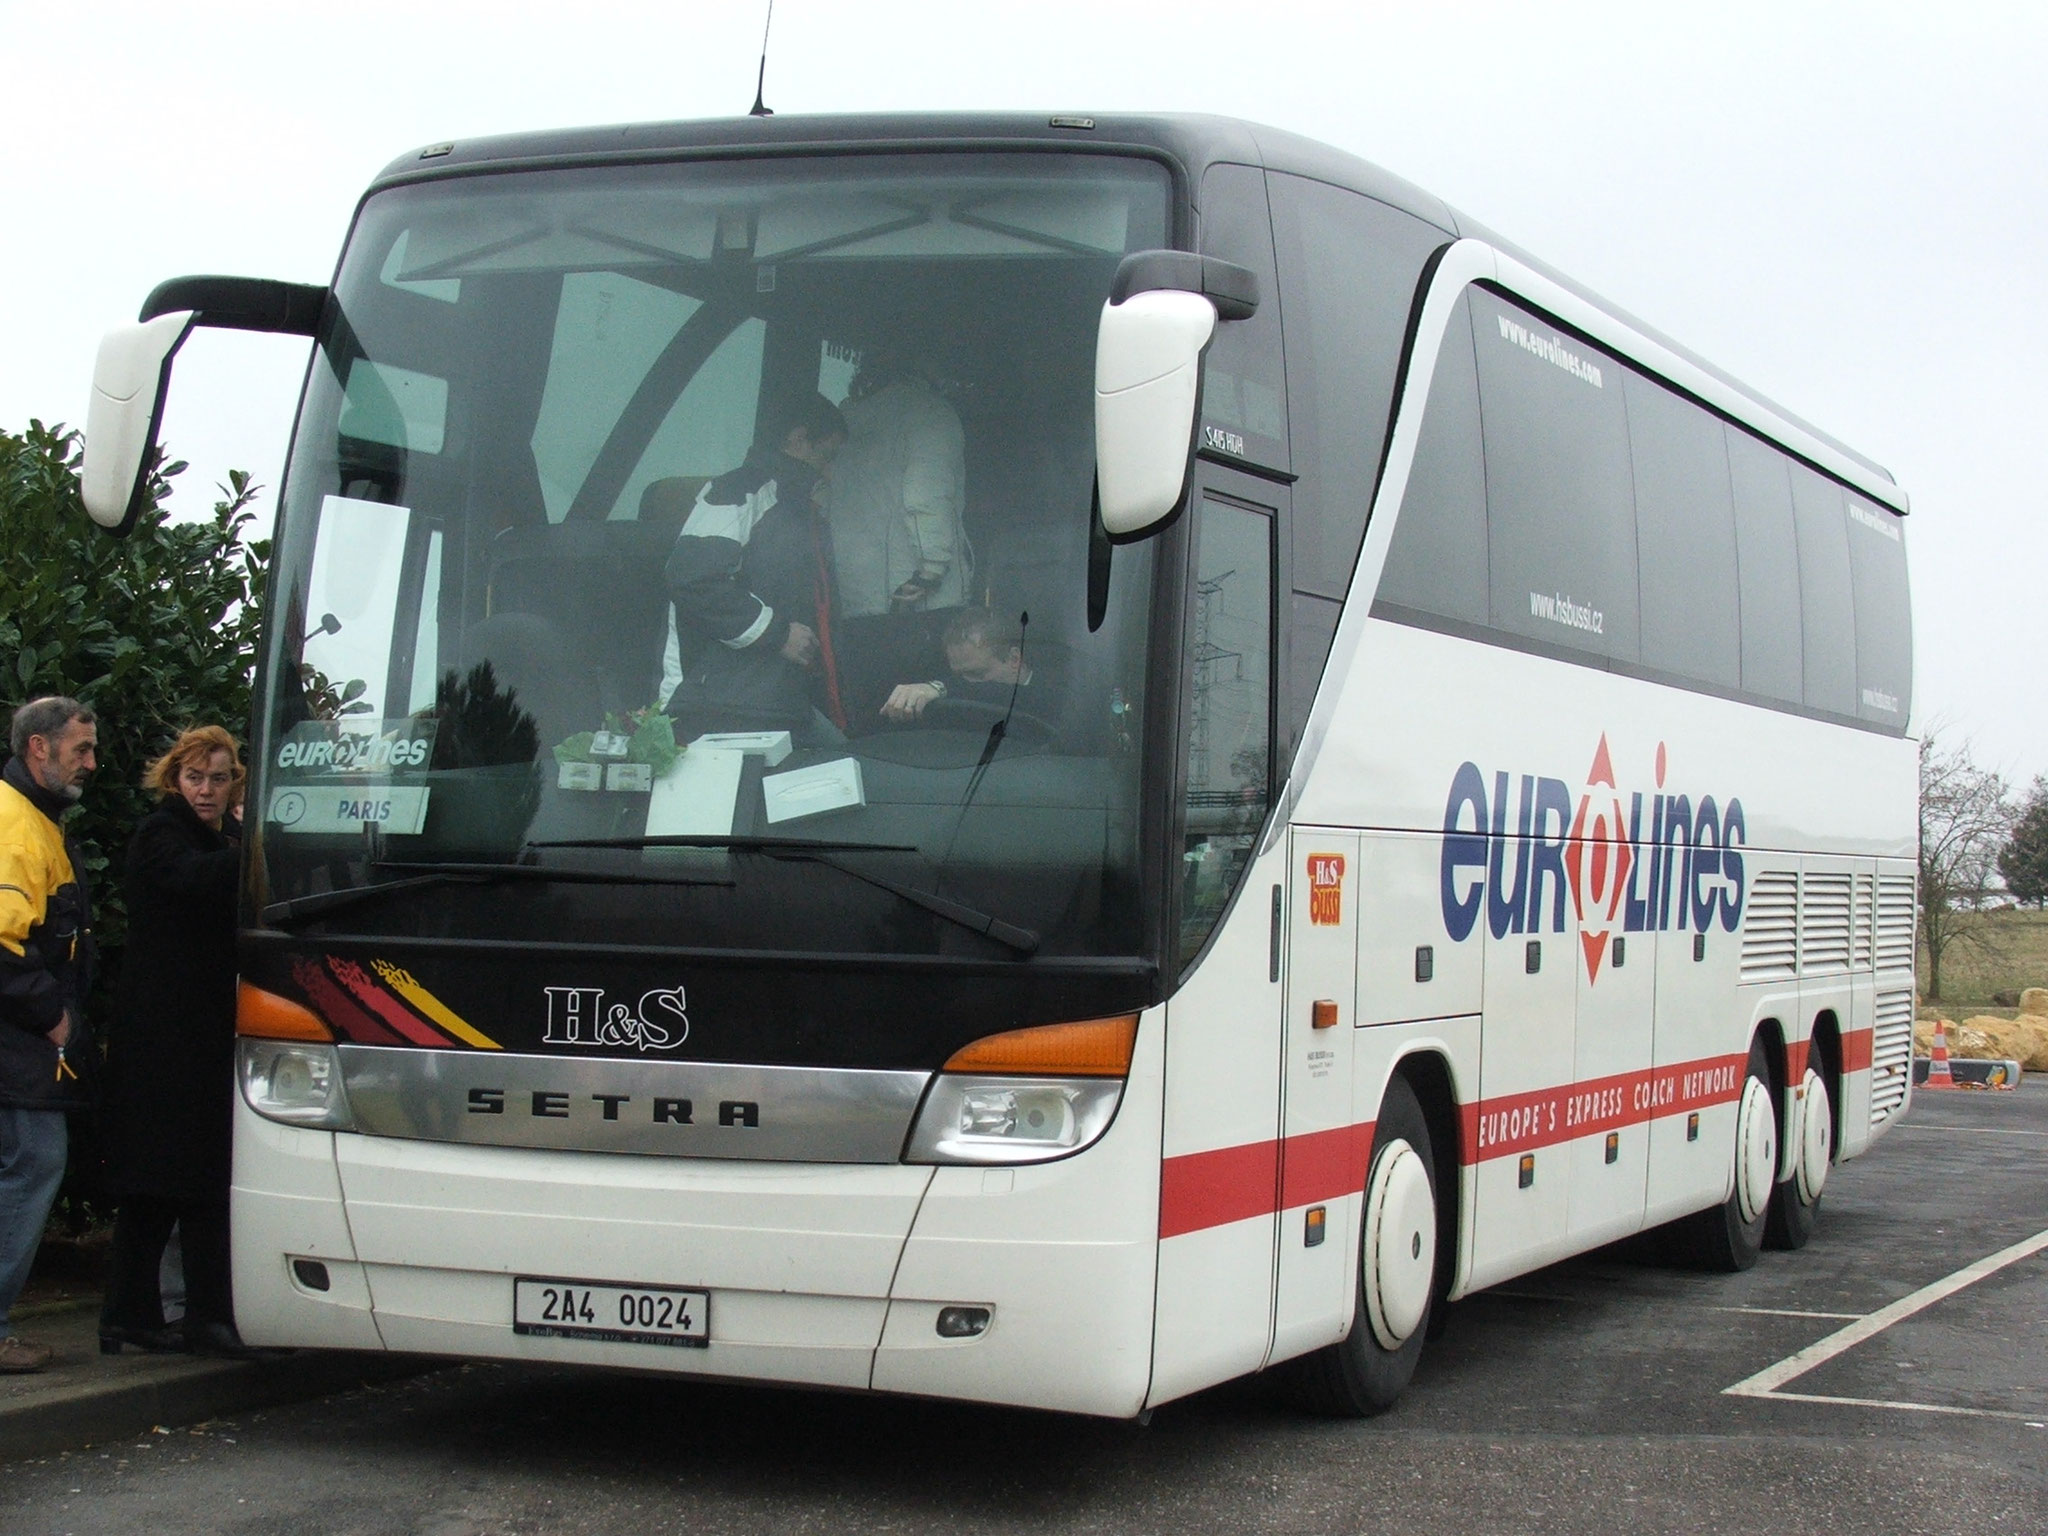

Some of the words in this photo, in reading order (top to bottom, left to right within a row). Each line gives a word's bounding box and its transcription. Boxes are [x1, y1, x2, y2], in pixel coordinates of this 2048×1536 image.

[1498, 315, 1602, 388] www.eurolines.com
[1530, 591, 1603, 634] www.hsbussi.cz
[337, 800, 391, 820] PARIS
[1315, 859, 1338, 886] H&S
[542, 986, 689, 1051] H&S
[468, 1088, 759, 1128] SETRA
[1479, 1101, 1557, 1148] EUROPE'S
[1566, 1086, 1623, 1127] EXPRESS
[1634, 1077, 1675, 1111] COACH
[1682, 1064, 1736, 1101] NETWORK
[542, 1288, 595, 1323] 2A4
[619, 1294, 692, 1330] 0024
